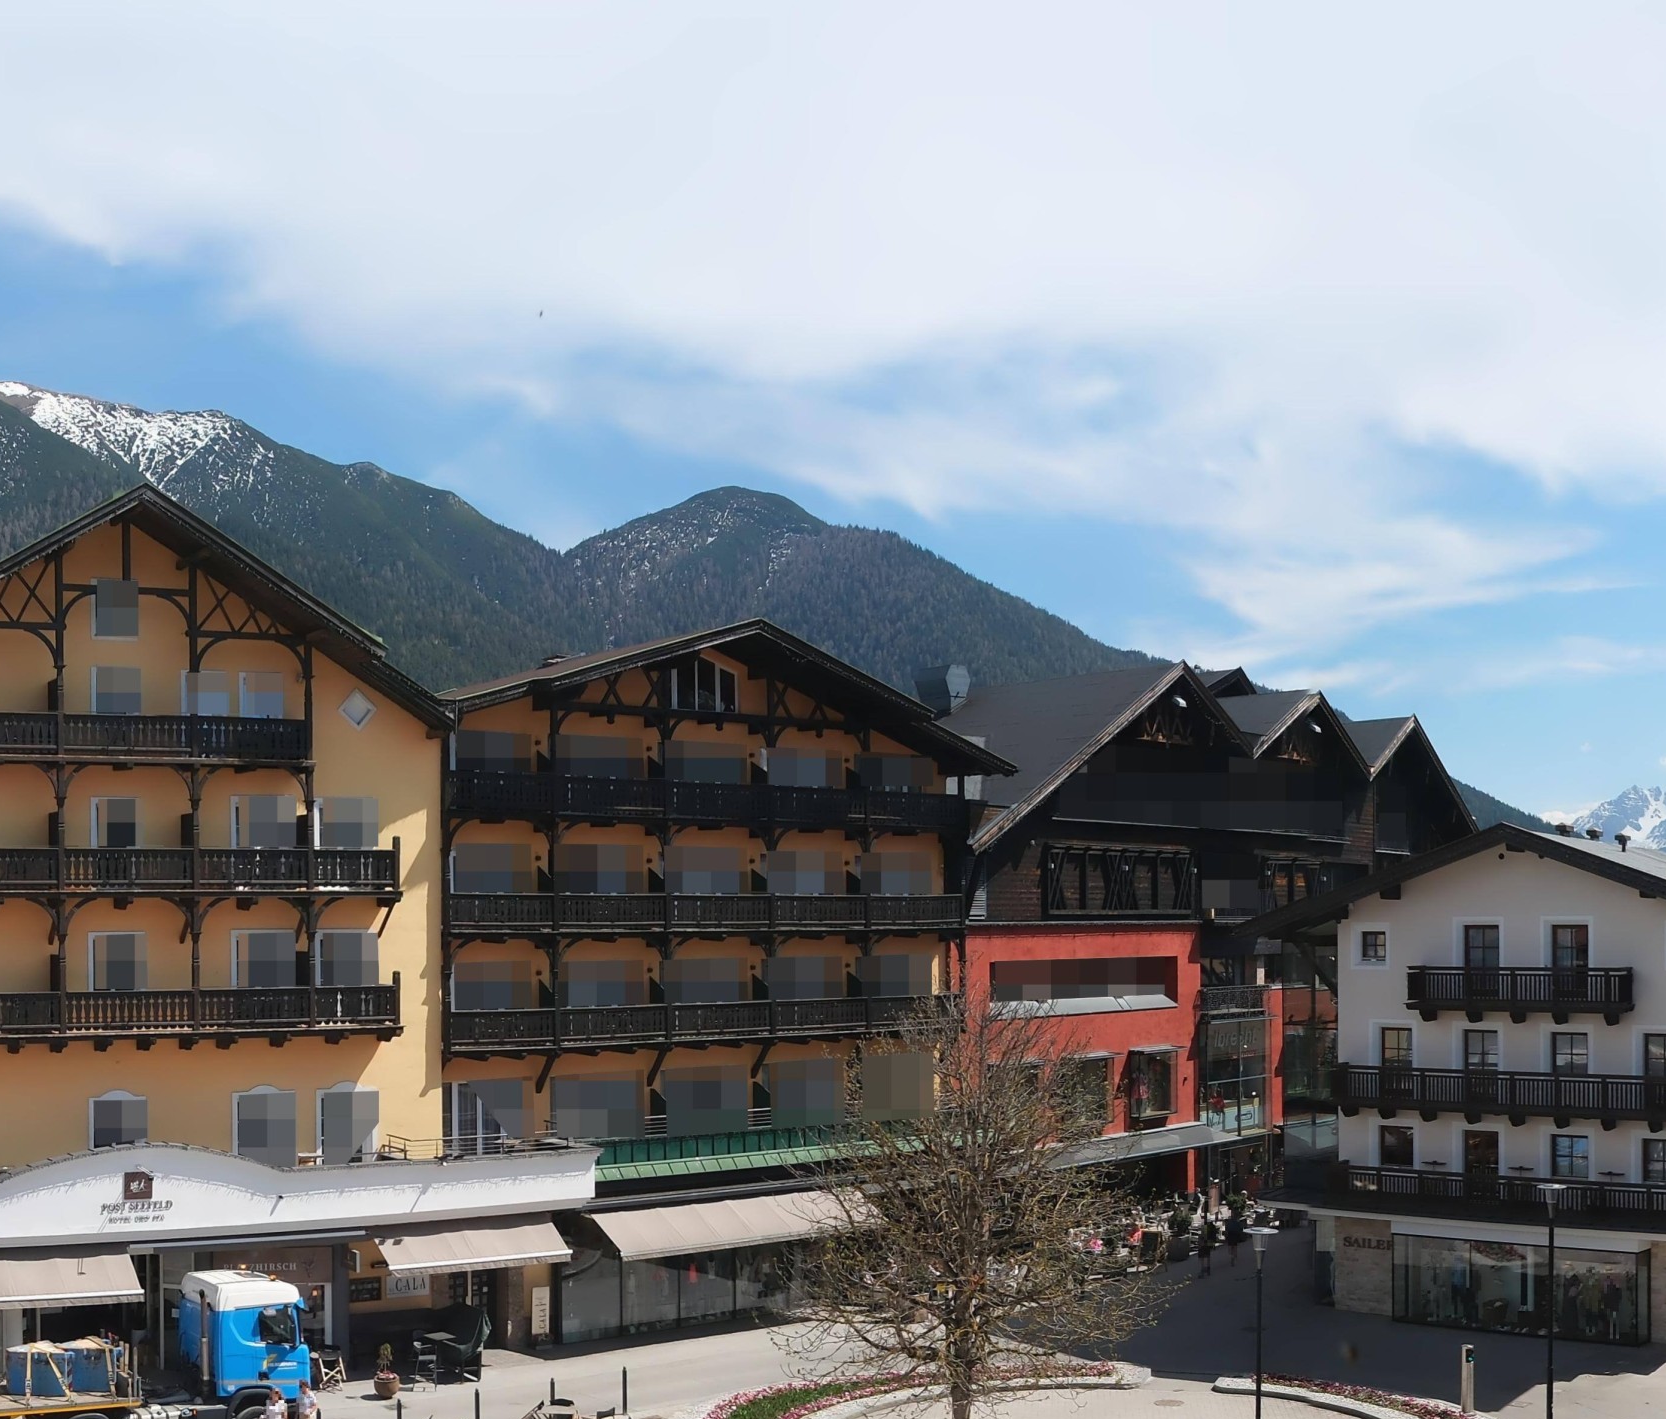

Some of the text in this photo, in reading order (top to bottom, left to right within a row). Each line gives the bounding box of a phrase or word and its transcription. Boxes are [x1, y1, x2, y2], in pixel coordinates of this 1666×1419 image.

[100, 1200, 173, 1215] POST SEEFELD
[223, 1262, 297, 1271] PLZHIRSCH
[394, 1276, 427, 1291] CALA
